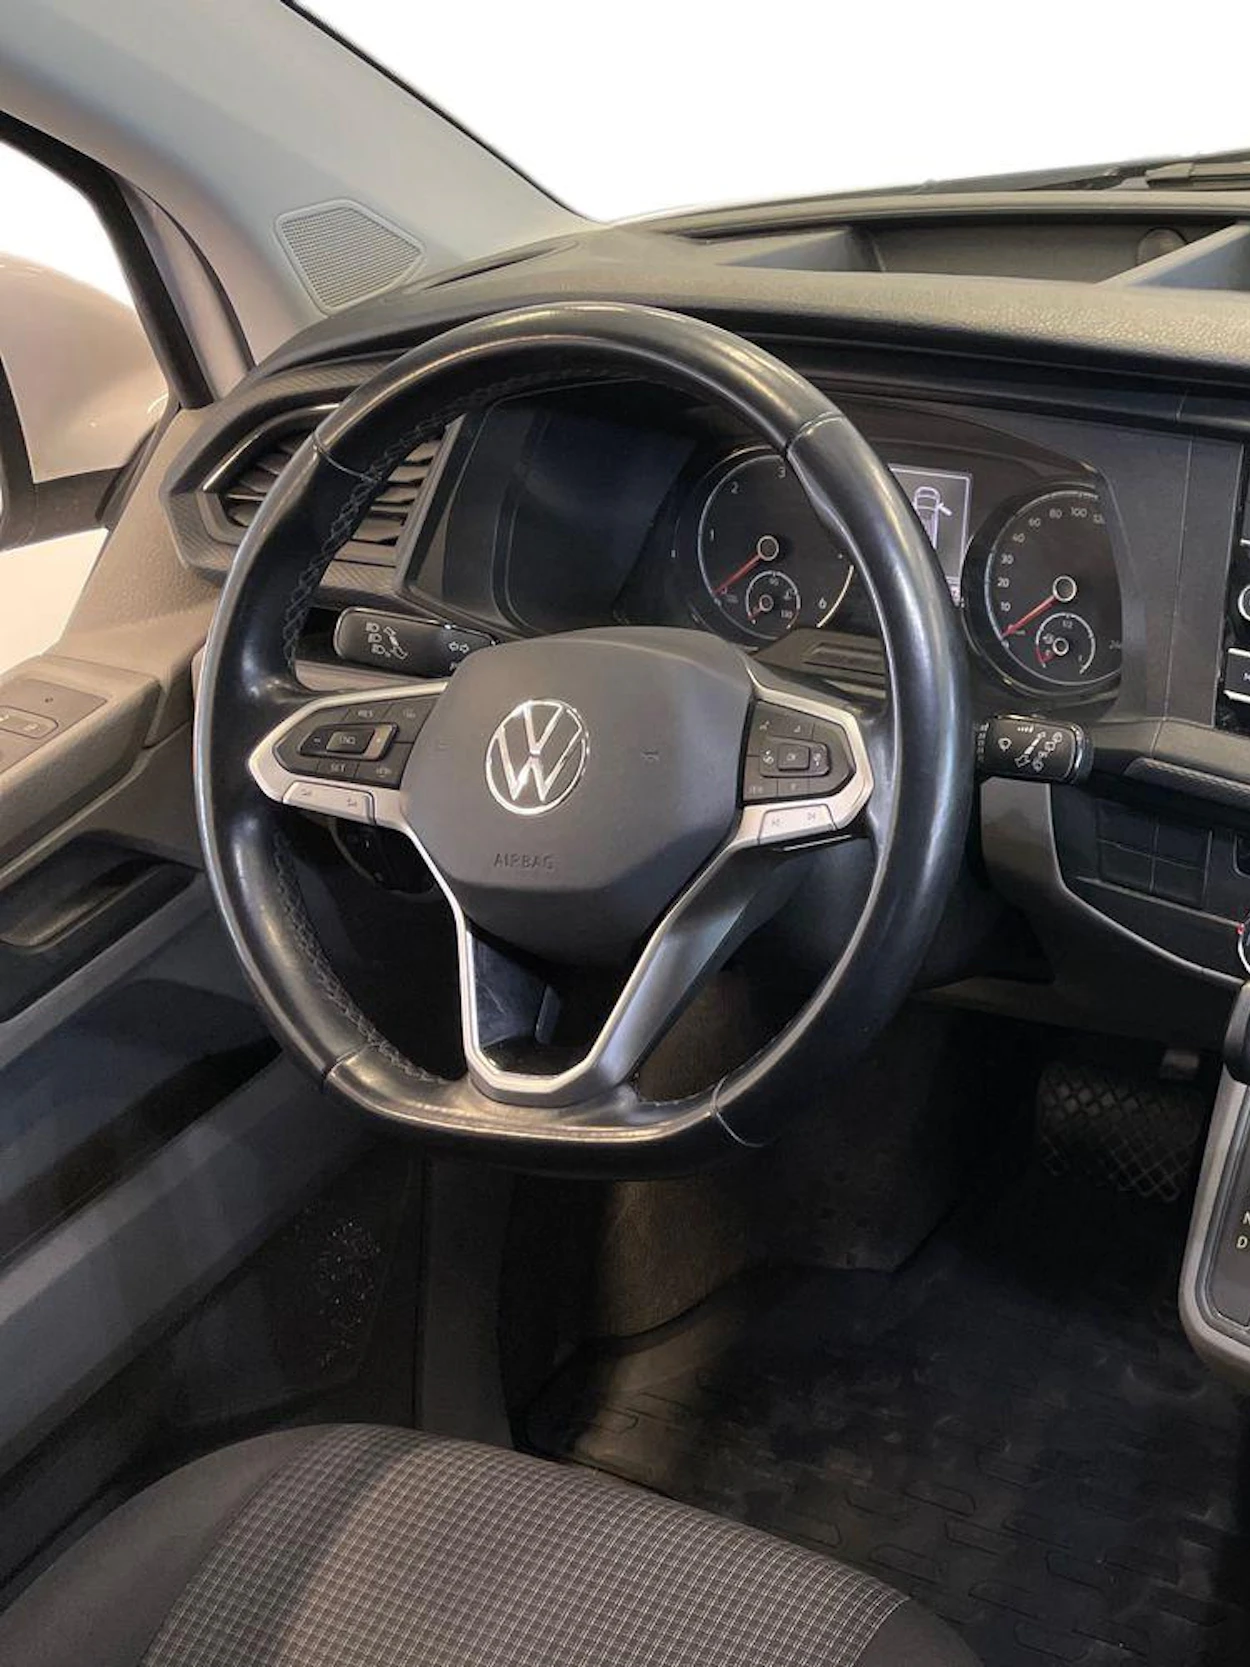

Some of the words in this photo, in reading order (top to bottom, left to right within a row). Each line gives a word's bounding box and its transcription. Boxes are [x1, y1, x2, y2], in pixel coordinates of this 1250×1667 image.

[1049, 508, 1062, 519] 80
[1071, 507, 1088, 518] 100
[1028, 517, 1041, 528] 60
[731, 481, 739, 494] 2
[777, 466, 786, 478] 3
[818, 597, 827, 609] 6
[1012, 533, 1026, 543] 40
[1001, 553, 1014, 564] 30
[997, 577, 1009, 588] 20
[1000, 602, 1011, 612] 10
[493, 853, 556, 870] AIRBAG
[1236, 1235, 1248, 1249] D
